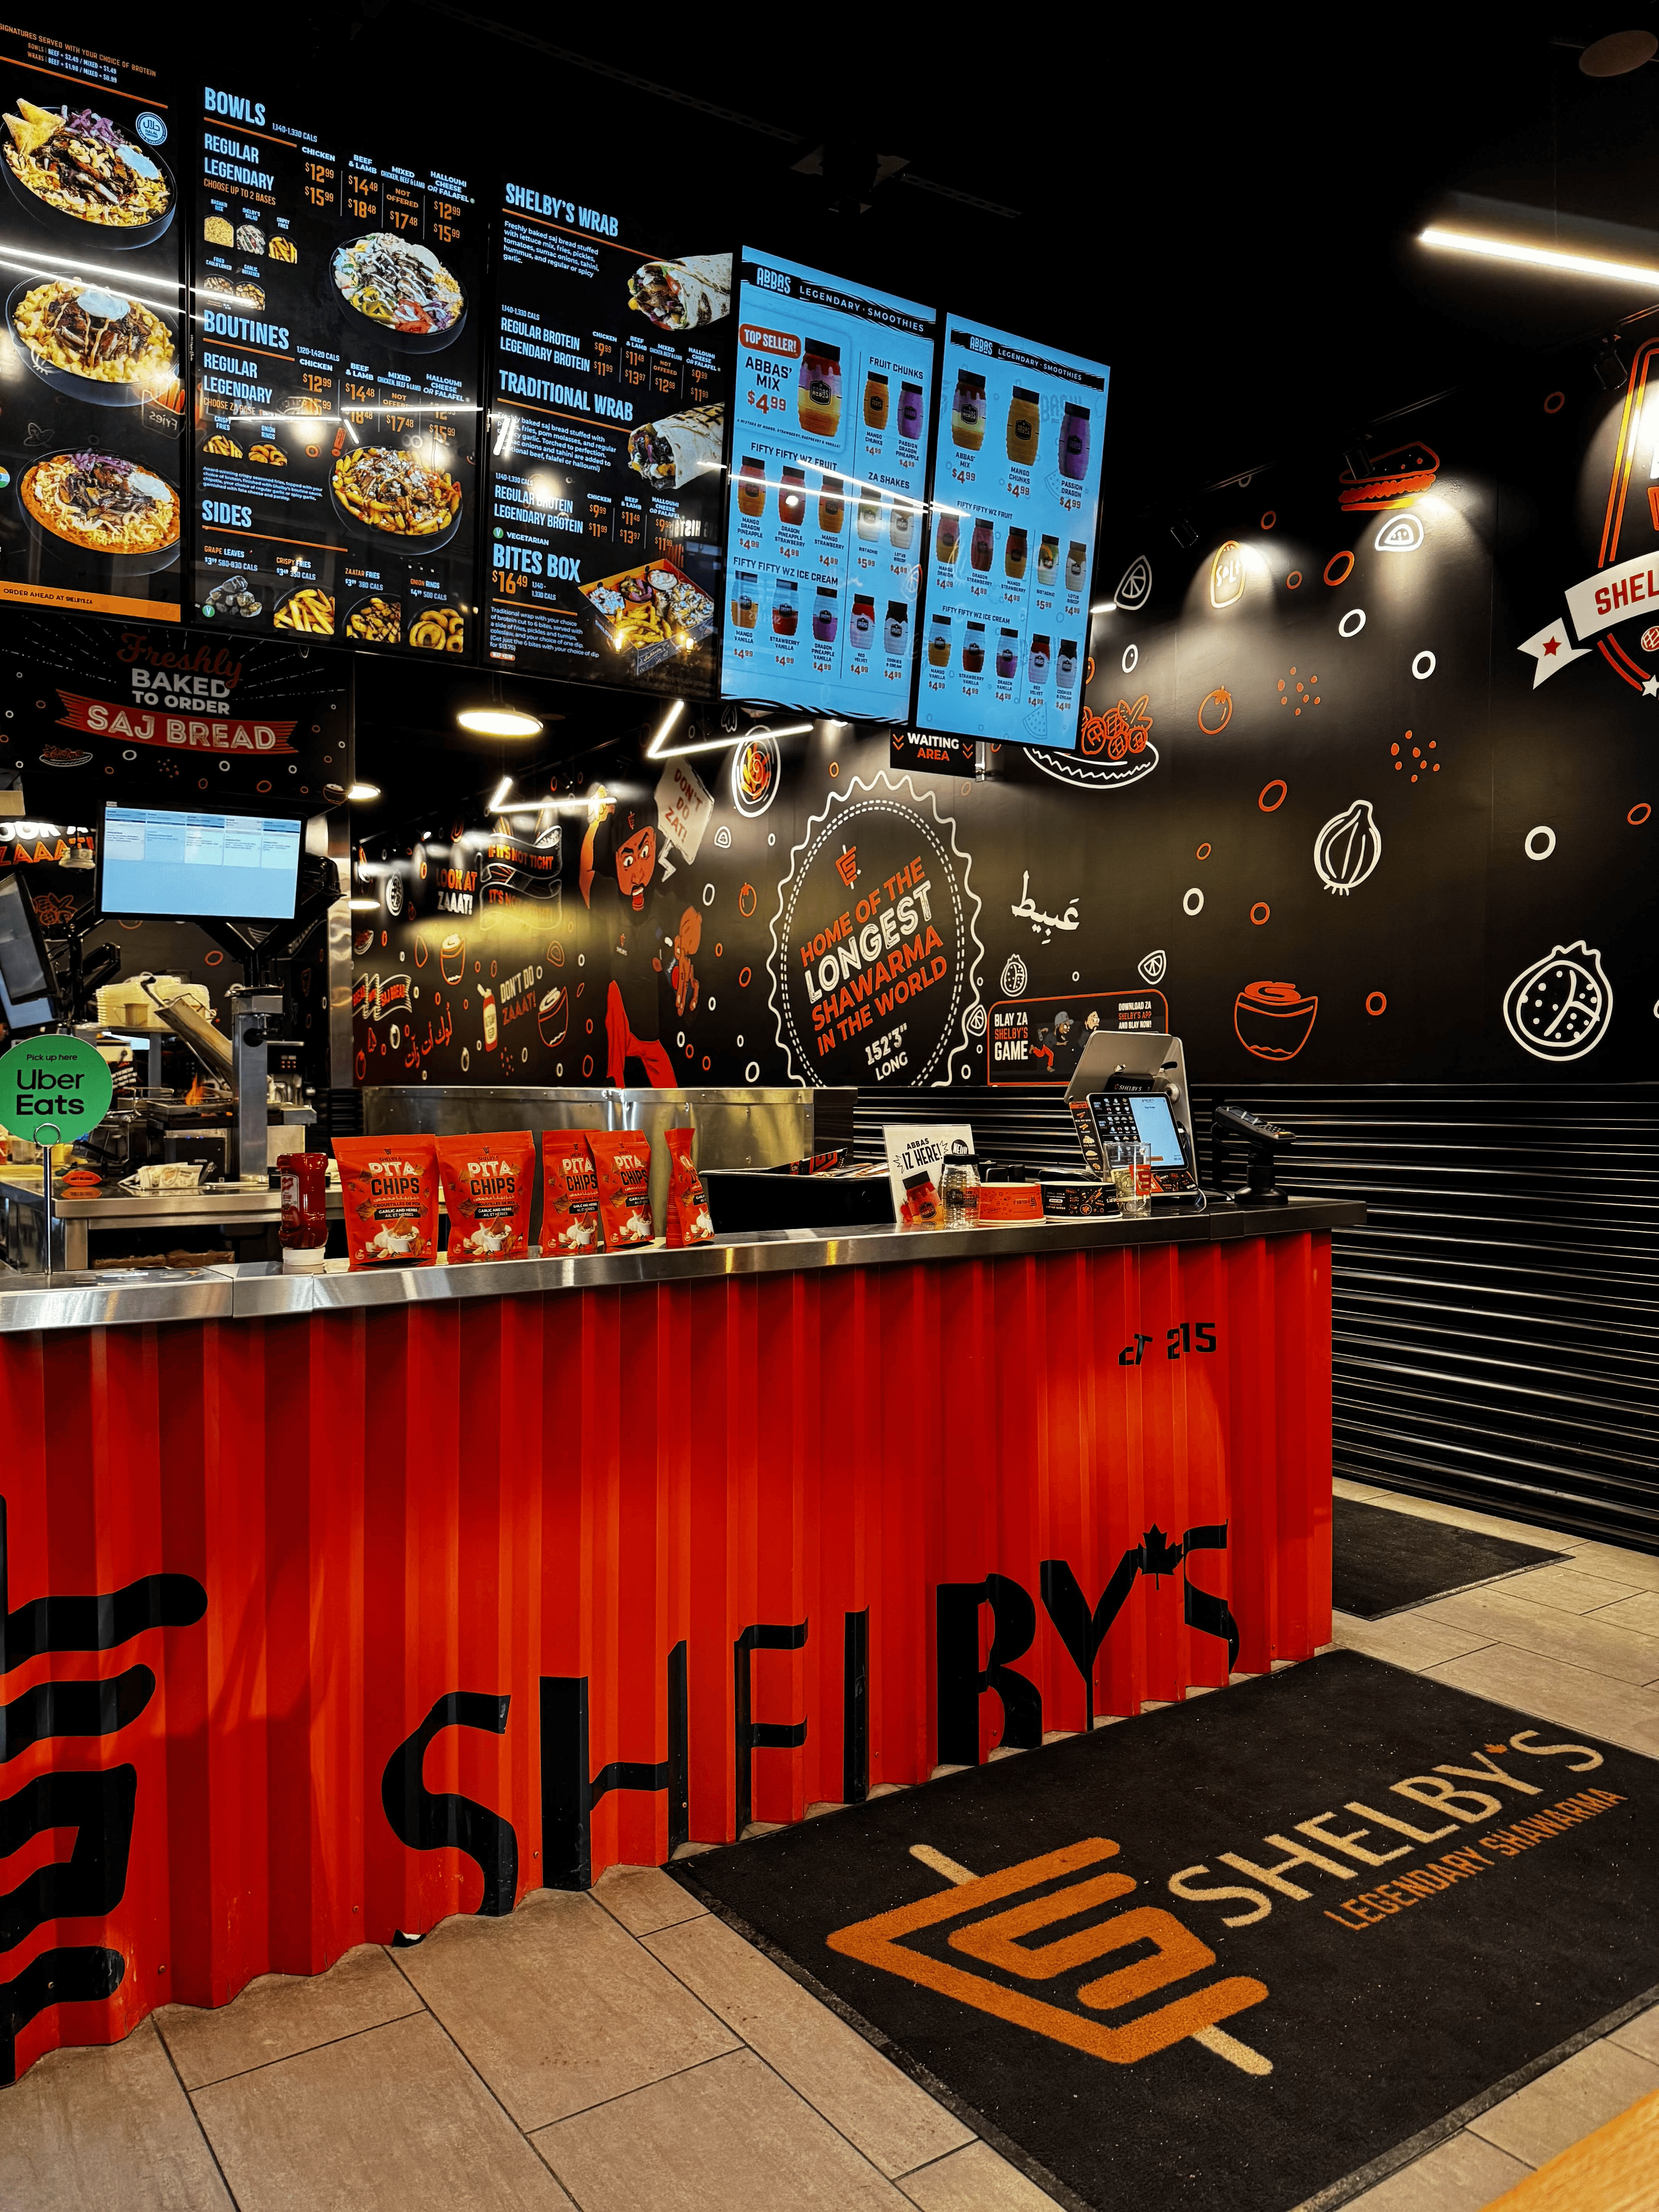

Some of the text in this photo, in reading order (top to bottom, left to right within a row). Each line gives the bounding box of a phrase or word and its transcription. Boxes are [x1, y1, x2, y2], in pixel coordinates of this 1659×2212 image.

[39, 36, 63, 48] SERVED
[65, 43, 80, 54] WITH
[82, 48, 97, 59] YOUR
[99, 54, 120, 66] CHOICE
[132, 64, 156, 77] BROTEIN
[204, 86, 266, 126] BOWLS
[204, 133, 259, 164] REGULAR
[302, 146, 335, 161] CHICKEN
[204, 157, 274, 191] LEGENDARY
[204, 178, 276, 205] CHOOSE UP TO 2 BASES
[505, 183, 618, 237] SHELBY'S WRAB
[505, 220, 527, 233] Freshly
[529, 228, 547, 239] baked
[559, 238, 576, 248] bread
[577, 245, 598, 255] stuffed
[756, 267, 924, 332] ABBAS LEGENDARY SMOOTHIES
[203, 309, 289, 350] BOUTINES
[501, 317, 580, 351] REGULAR BROTEIN
[744, 329, 796, 353] TOP SELLER!
[500, 336, 590, 372] LEGENDARY BROTEIN
[970, 336, 1081, 381] ABBAS LEGENDARY SMOOTHIES
[745, 356, 792, 379] ABBAS'
[870, 356, 923, 380] FRUIT CHUNKS
[499, 369, 633, 421] TRADITIONAL WRAB
[756, 374, 780, 392] MIX
[751, 442, 774, 456] FIFTY
[776, 448, 798, 462] FIFTY
[815, 458, 837, 470] FRUIT
[869, 472, 909, 489] ZA SHAKES
[202, 499, 251, 528] SIDES
[507, 531, 549, 546] VEGETARIAN
[493, 543, 580, 583] BITES BOX
[734, 556, 838, 585] FIFTY FIFTY WZ ICE CREAM
[30, 591, 54, 600] AHEAD
[117, 632, 244, 689] Freshly
[132, 668, 230, 699] BAKED
[132, 690, 230, 715] TO ORDER
[87, 705, 276, 750] SAJ BREAD
[907, 733, 959, 749] WAITING
[917, 747, 950, 761] AREA
[674, 768, 702, 812] DON'T
[677, 800, 690, 819] DO
[665, 807, 687, 843] ZAT!
[512, 847, 528, 864] NOT
[530, 855, 553, 870] TIGHT
[436, 868, 477, 892] LOOK AT
[438, 891, 473, 915] ZAAAT!
[489, 889, 503, 905] IT'S
[800, 856, 925, 967] HOME OF THE
[805, 880, 931, 1004] LONGEST
[500, 965, 534, 1004] DON'T DO
[812, 925, 943, 1031] SHAWARMA
[502, 991, 536, 1025] ZAAAT!
[817, 956, 947, 1056] IN THE WORLD
[1118, 1012, 1141, 1020] SHELBY'S
[1119, 1002, 1143, 1011] DOWNLOAD
[995, 1012, 1027, 1027] BLAY ZA
[995, 1027, 1028, 1039] SHELBY'S
[995, 1041, 1028, 1061] GAME
[875, 1051, 908, 1081] LONG
[17, 1069, 85, 1090] Uber
[16, 1093, 85, 1116] Eats
[902, 1143, 943, 1170] IZ HERE!
[907, 1138, 929, 1150] ABBAS
[369, 1161, 418, 1177] PITA
[468, 1161, 514, 1177] PITA
[563, 1157, 594, 1174] PITA
[614, 1155, 644, 1170] PITA
[372, 1177, 420, 1196] CHIPS
[470, 1177, 515, 1195] CHIPS
[566, 1174, 597, 1191] CHIPS
[620, 1169, 648, 1185] CHIPS
[1323, 1788, 1628, 1931] LEGENDARY SHAWARMA
